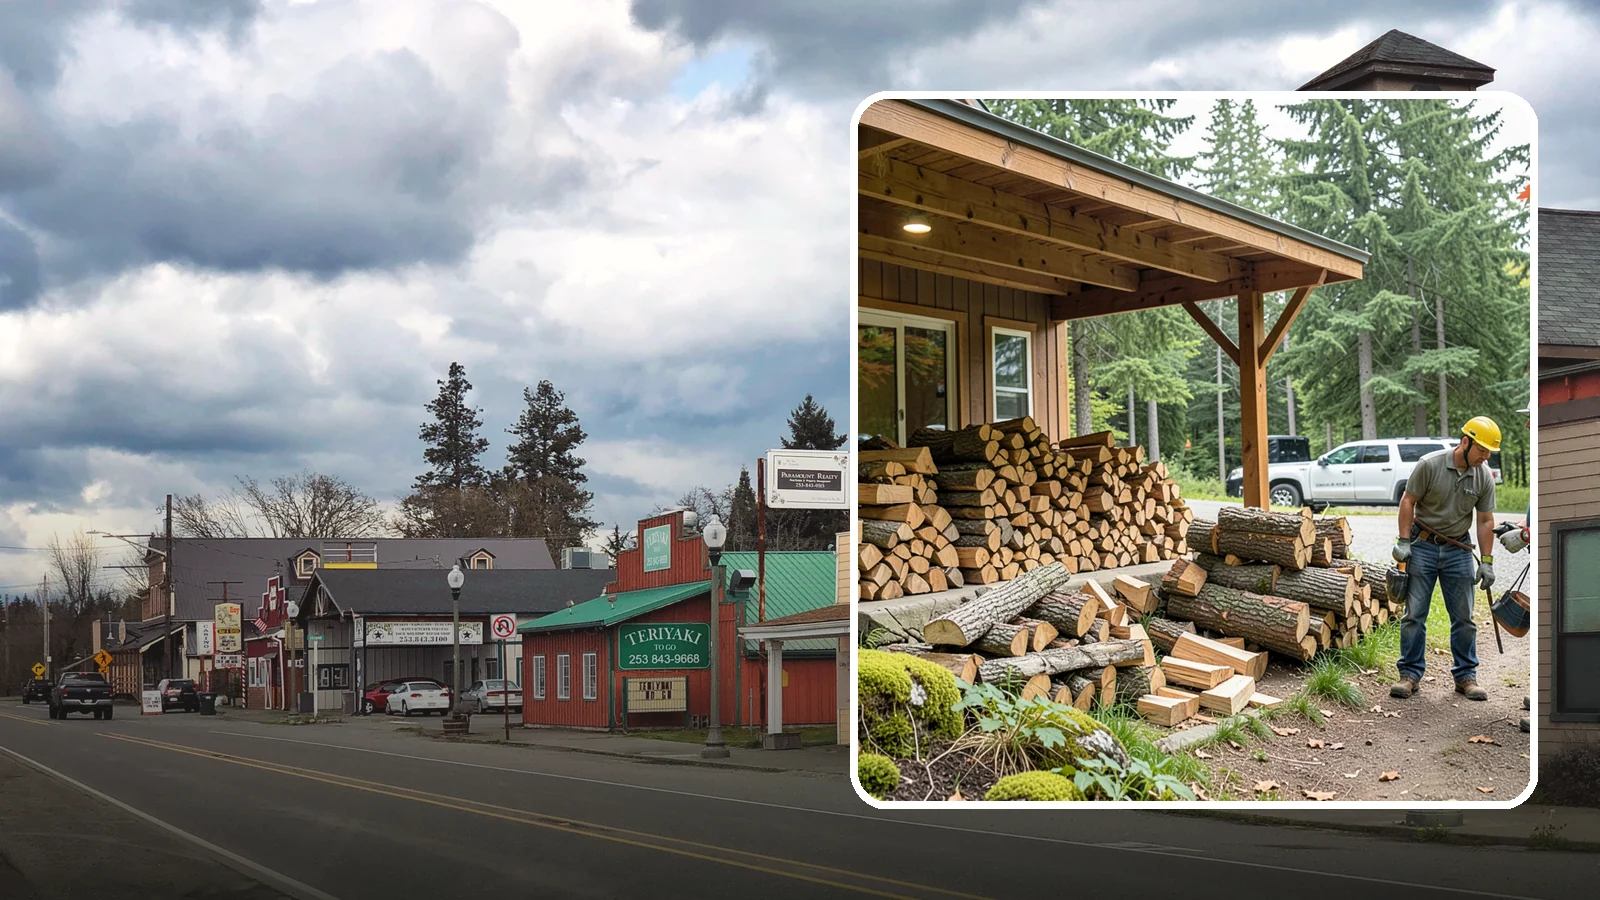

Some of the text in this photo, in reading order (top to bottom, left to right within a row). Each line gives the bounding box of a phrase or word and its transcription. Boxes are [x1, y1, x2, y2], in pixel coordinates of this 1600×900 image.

[781, 471, 814, 479] PARAMOUNT
[625, 627, 702, 646] TERIYAKI
[654, 643, 677, 651] TO GO
[629, 653, 700, 664] 253 843-9668
